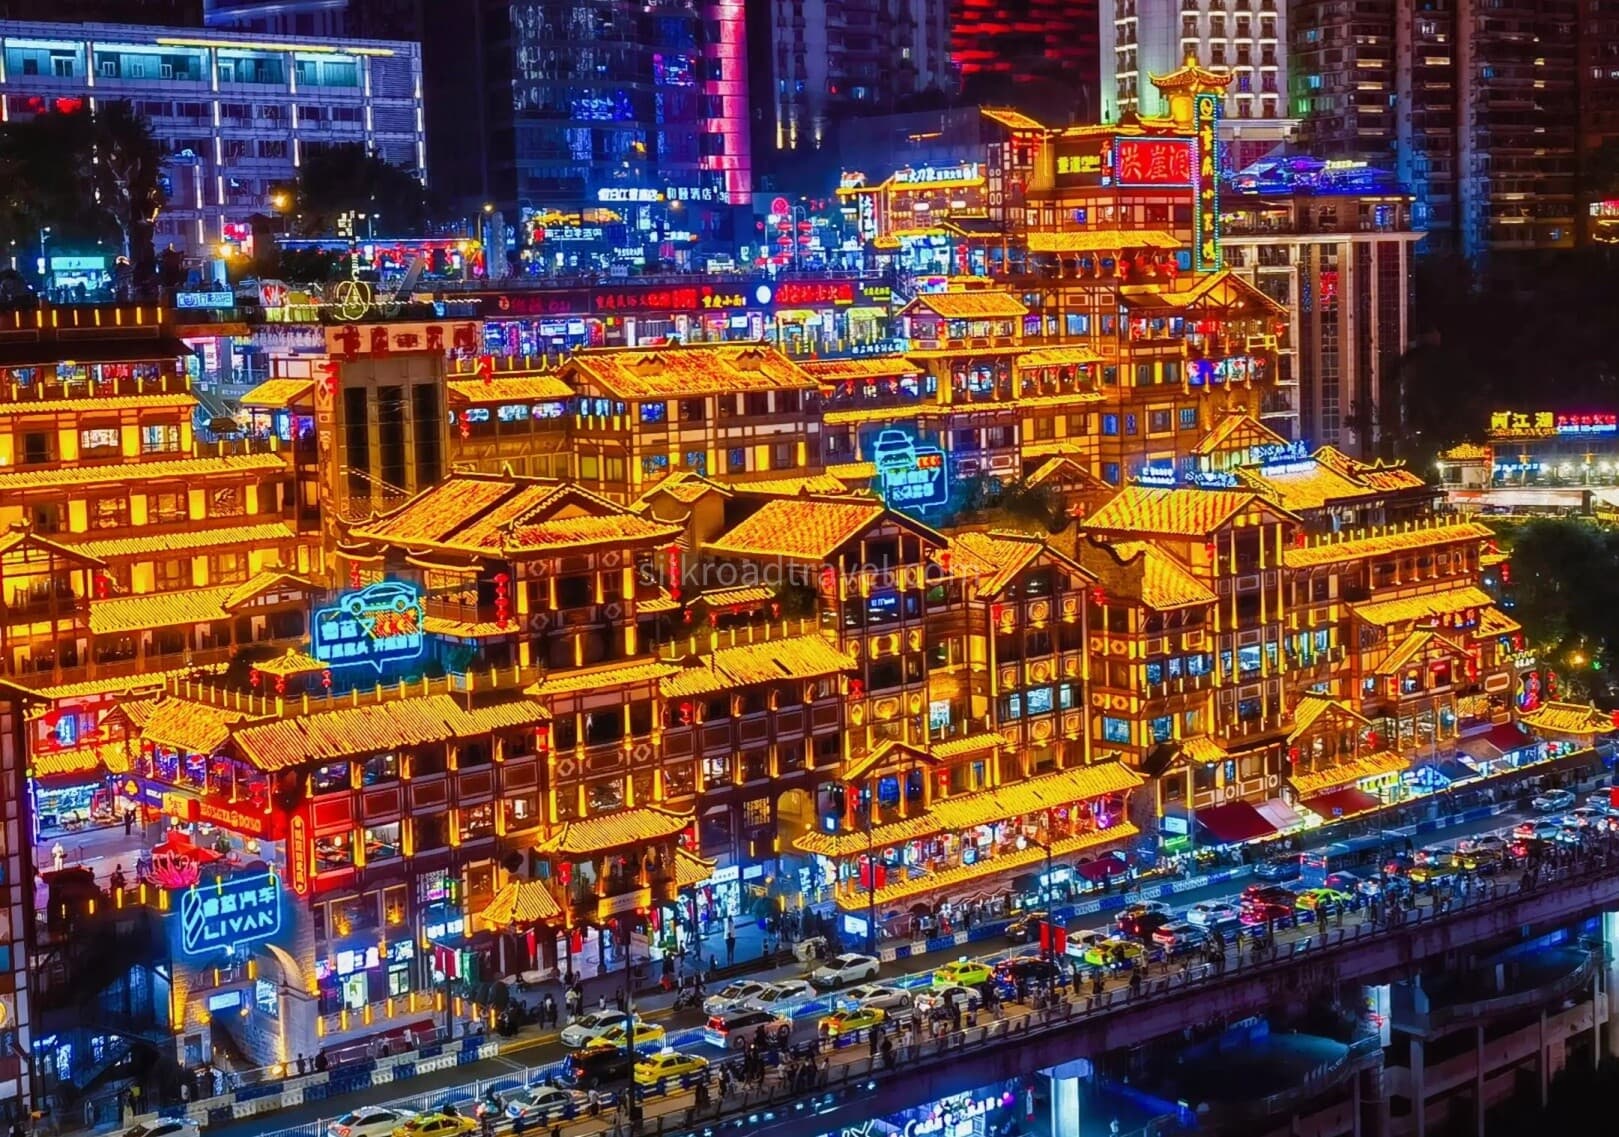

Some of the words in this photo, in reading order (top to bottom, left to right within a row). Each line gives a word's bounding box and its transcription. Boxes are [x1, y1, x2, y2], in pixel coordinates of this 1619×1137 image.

[1119, 144, 1190, 180] 洪崖洞
[204, 910, 274, 940] LIVAN
